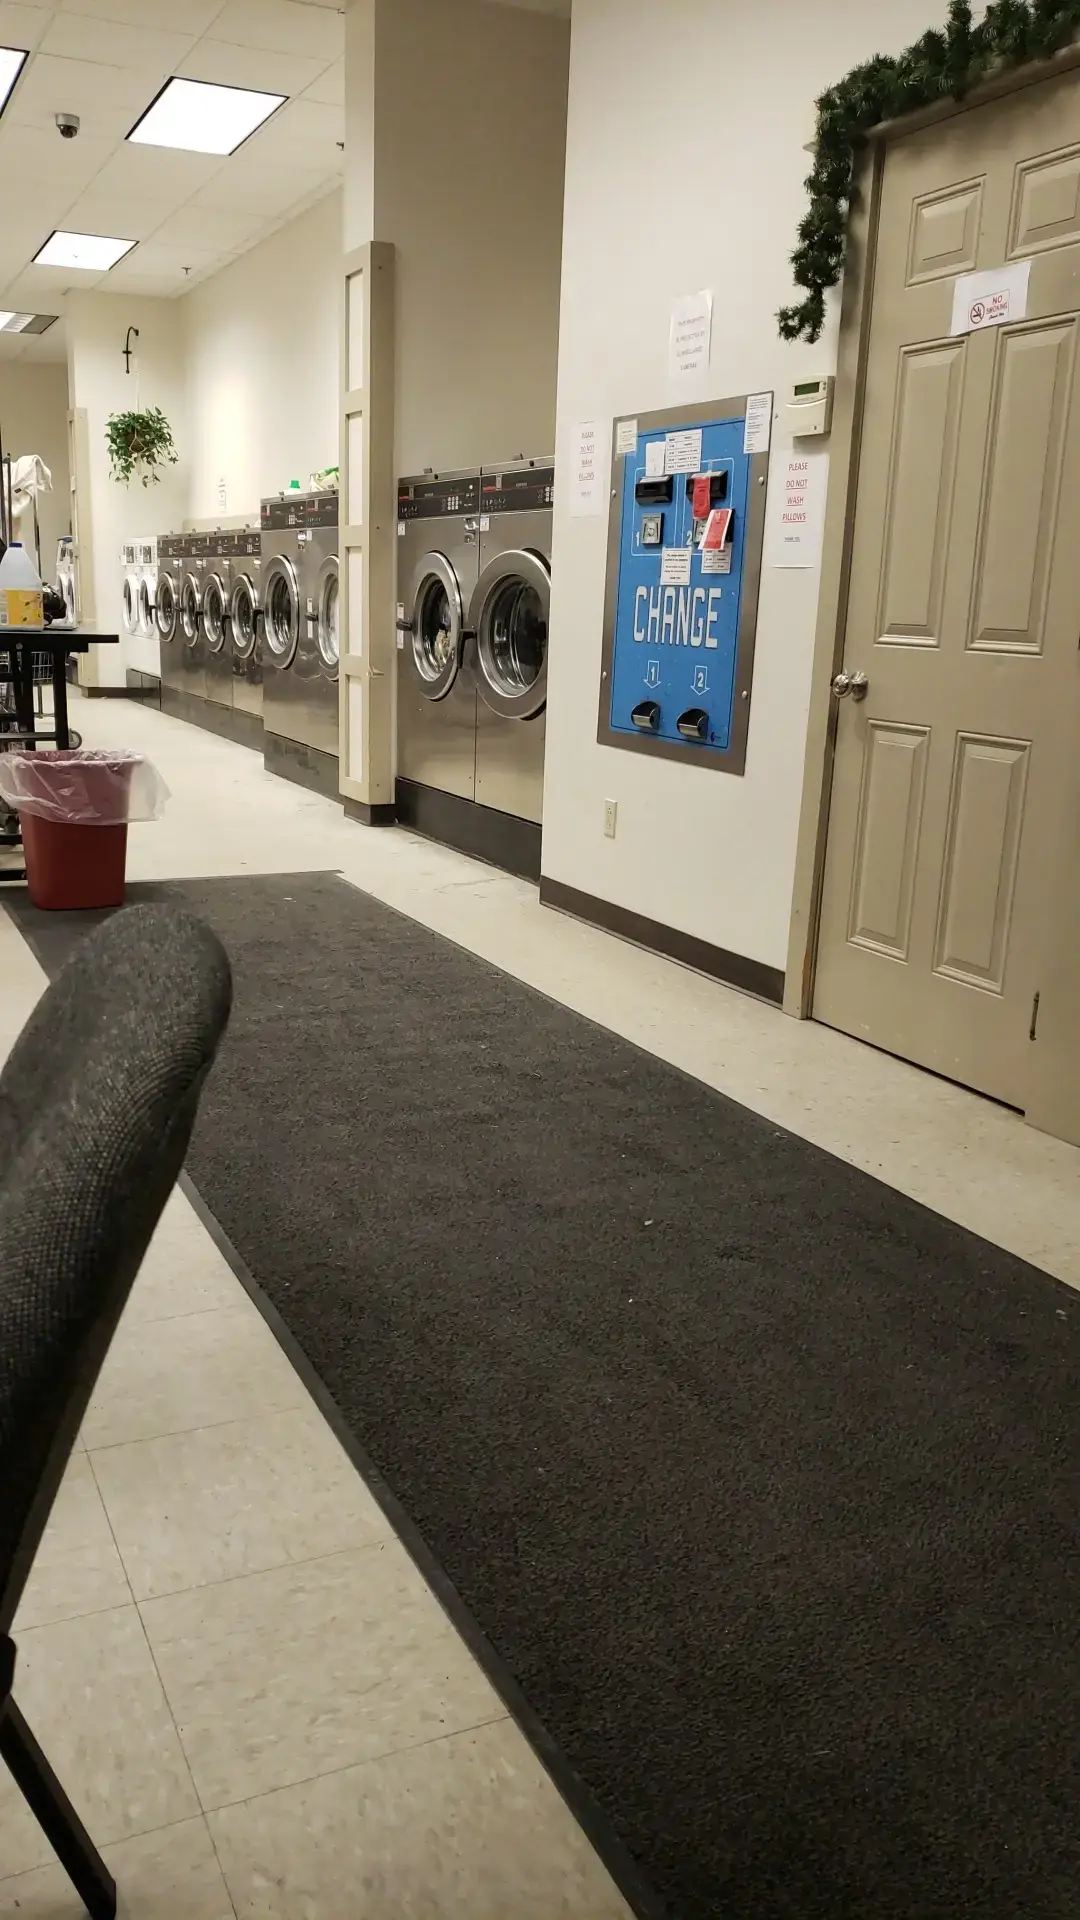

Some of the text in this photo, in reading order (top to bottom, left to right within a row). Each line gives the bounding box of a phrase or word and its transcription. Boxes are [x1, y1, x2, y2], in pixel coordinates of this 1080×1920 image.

[993, 295, 1003, 305] NO
[986, 302, 1007, 313] SMOKING
[789, 462, 808, 471] PLEASE
[786, 479, 808, 488] DO NOT
[787, 496, 804, 505] WASH
[782, 513, 806, 521] PILLOWS
[686, 530, 693, 546] 2
[633, 586, 722, 648] CHANGE
[650, 666, 656, 682] 1
[697, 671, 704, 688] 2
